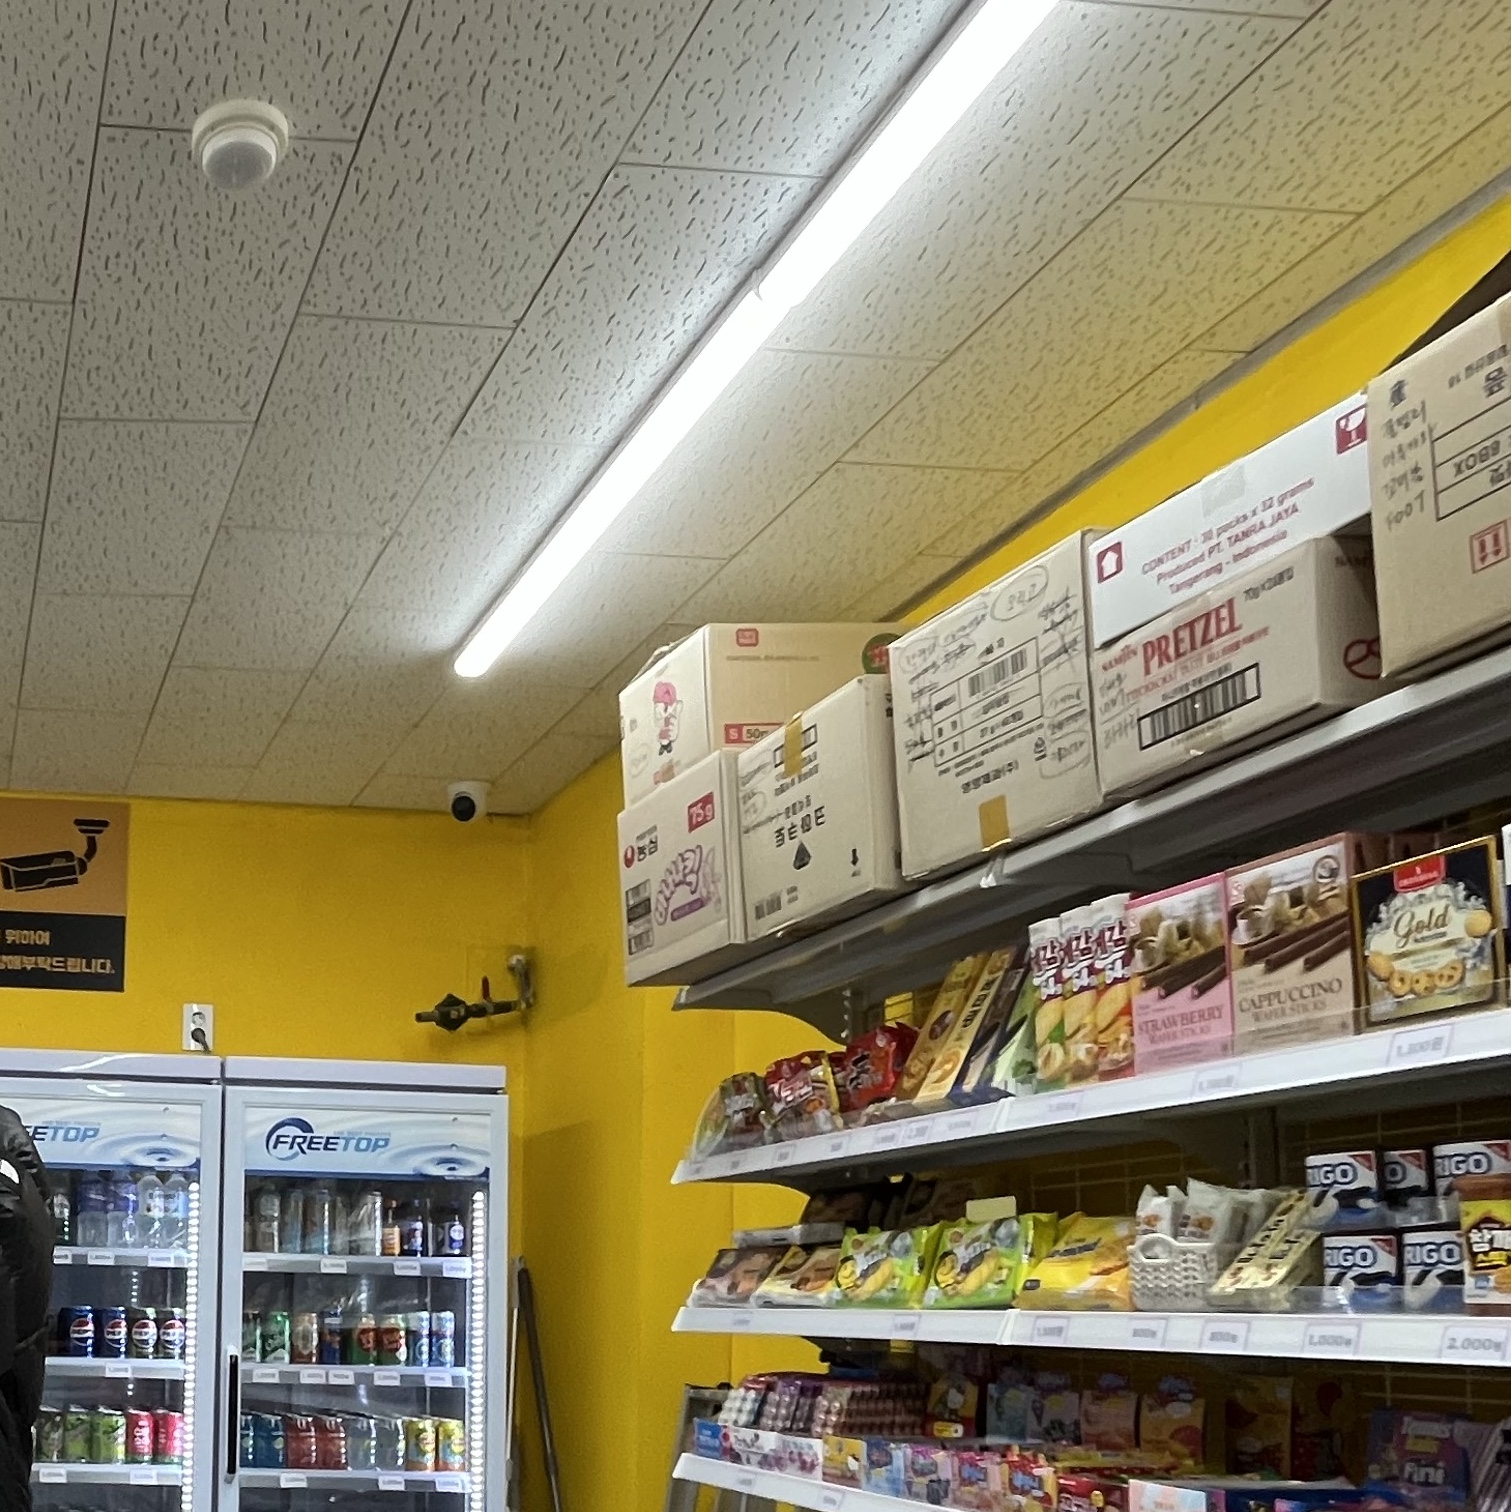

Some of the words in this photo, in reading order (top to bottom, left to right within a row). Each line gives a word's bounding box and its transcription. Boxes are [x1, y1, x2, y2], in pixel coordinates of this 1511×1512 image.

[1142, 597, 1243, 677] PRETZEL
[6, 928, 52, 946] 위하여
[1394, 907, 1451, 947] Gold
[1237, 976, 1344, 1013] CAPPUCCINO
[271, 1133, 391, 1155] FREETOP
